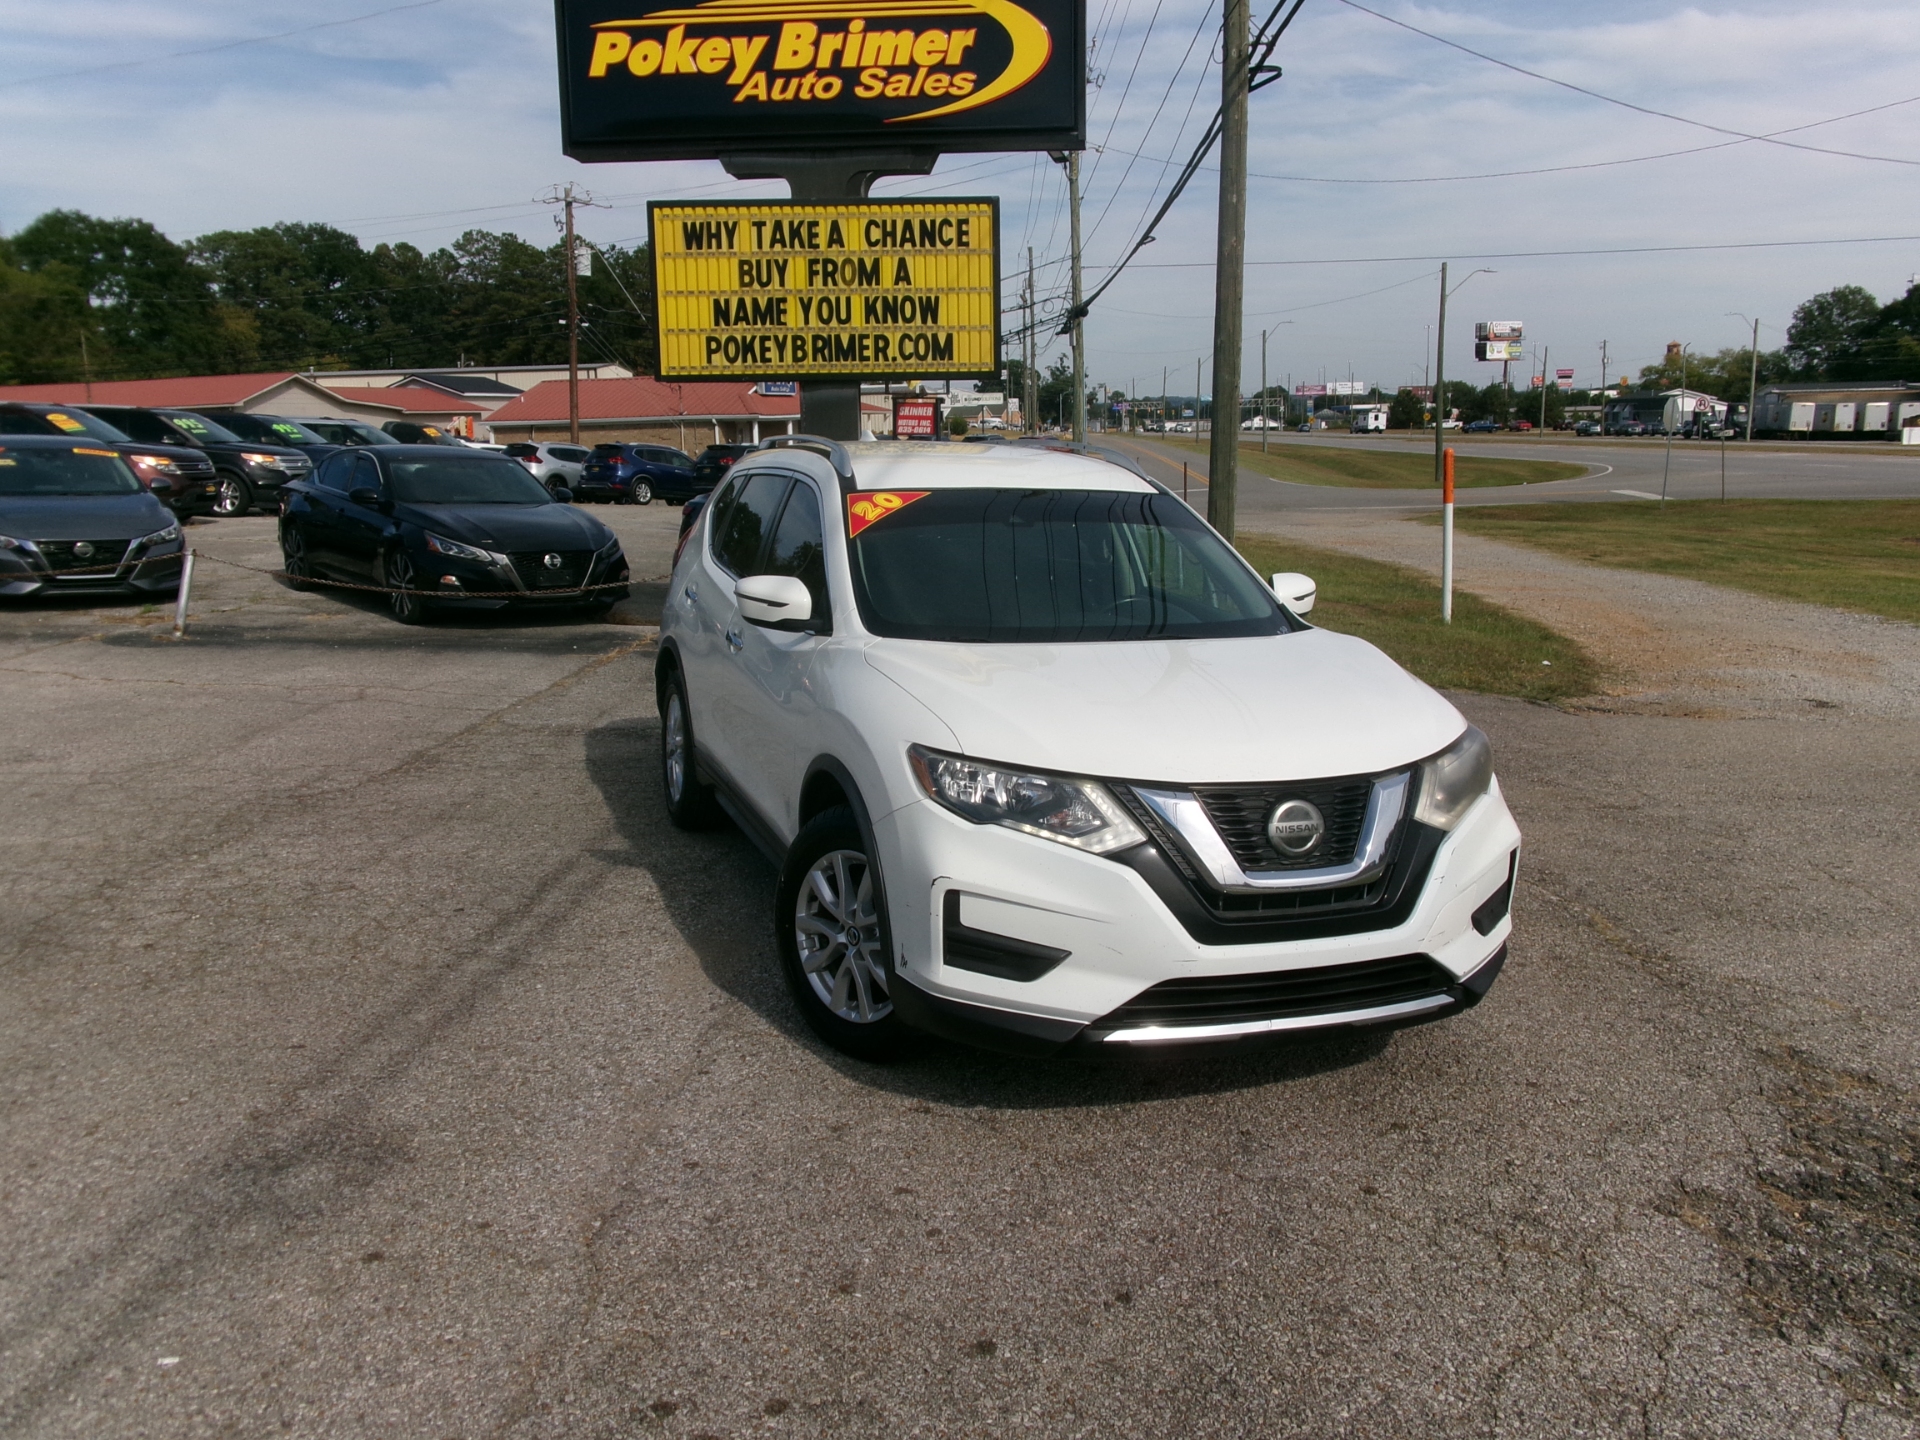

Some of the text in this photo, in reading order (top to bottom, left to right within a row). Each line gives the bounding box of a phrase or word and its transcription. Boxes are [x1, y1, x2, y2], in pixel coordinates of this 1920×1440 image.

[588, 18, 977, 85] Pokey Brimer
[734, 66, 977, 102] Auto Sales
[682, 218, 969, 250] WHY TAKE A CHANCE
[738, 257, 912, 288] BUY FROM A
[713, 295, 940, 327] NAME YOU KNOW
[705, 333, 954, 364] POKEYBRIMER.COM
[899, 406, 933, 416] SKINNER
[851, 493, 902, 521] 20
[1276, 823, 1317, 833] NISSAN
